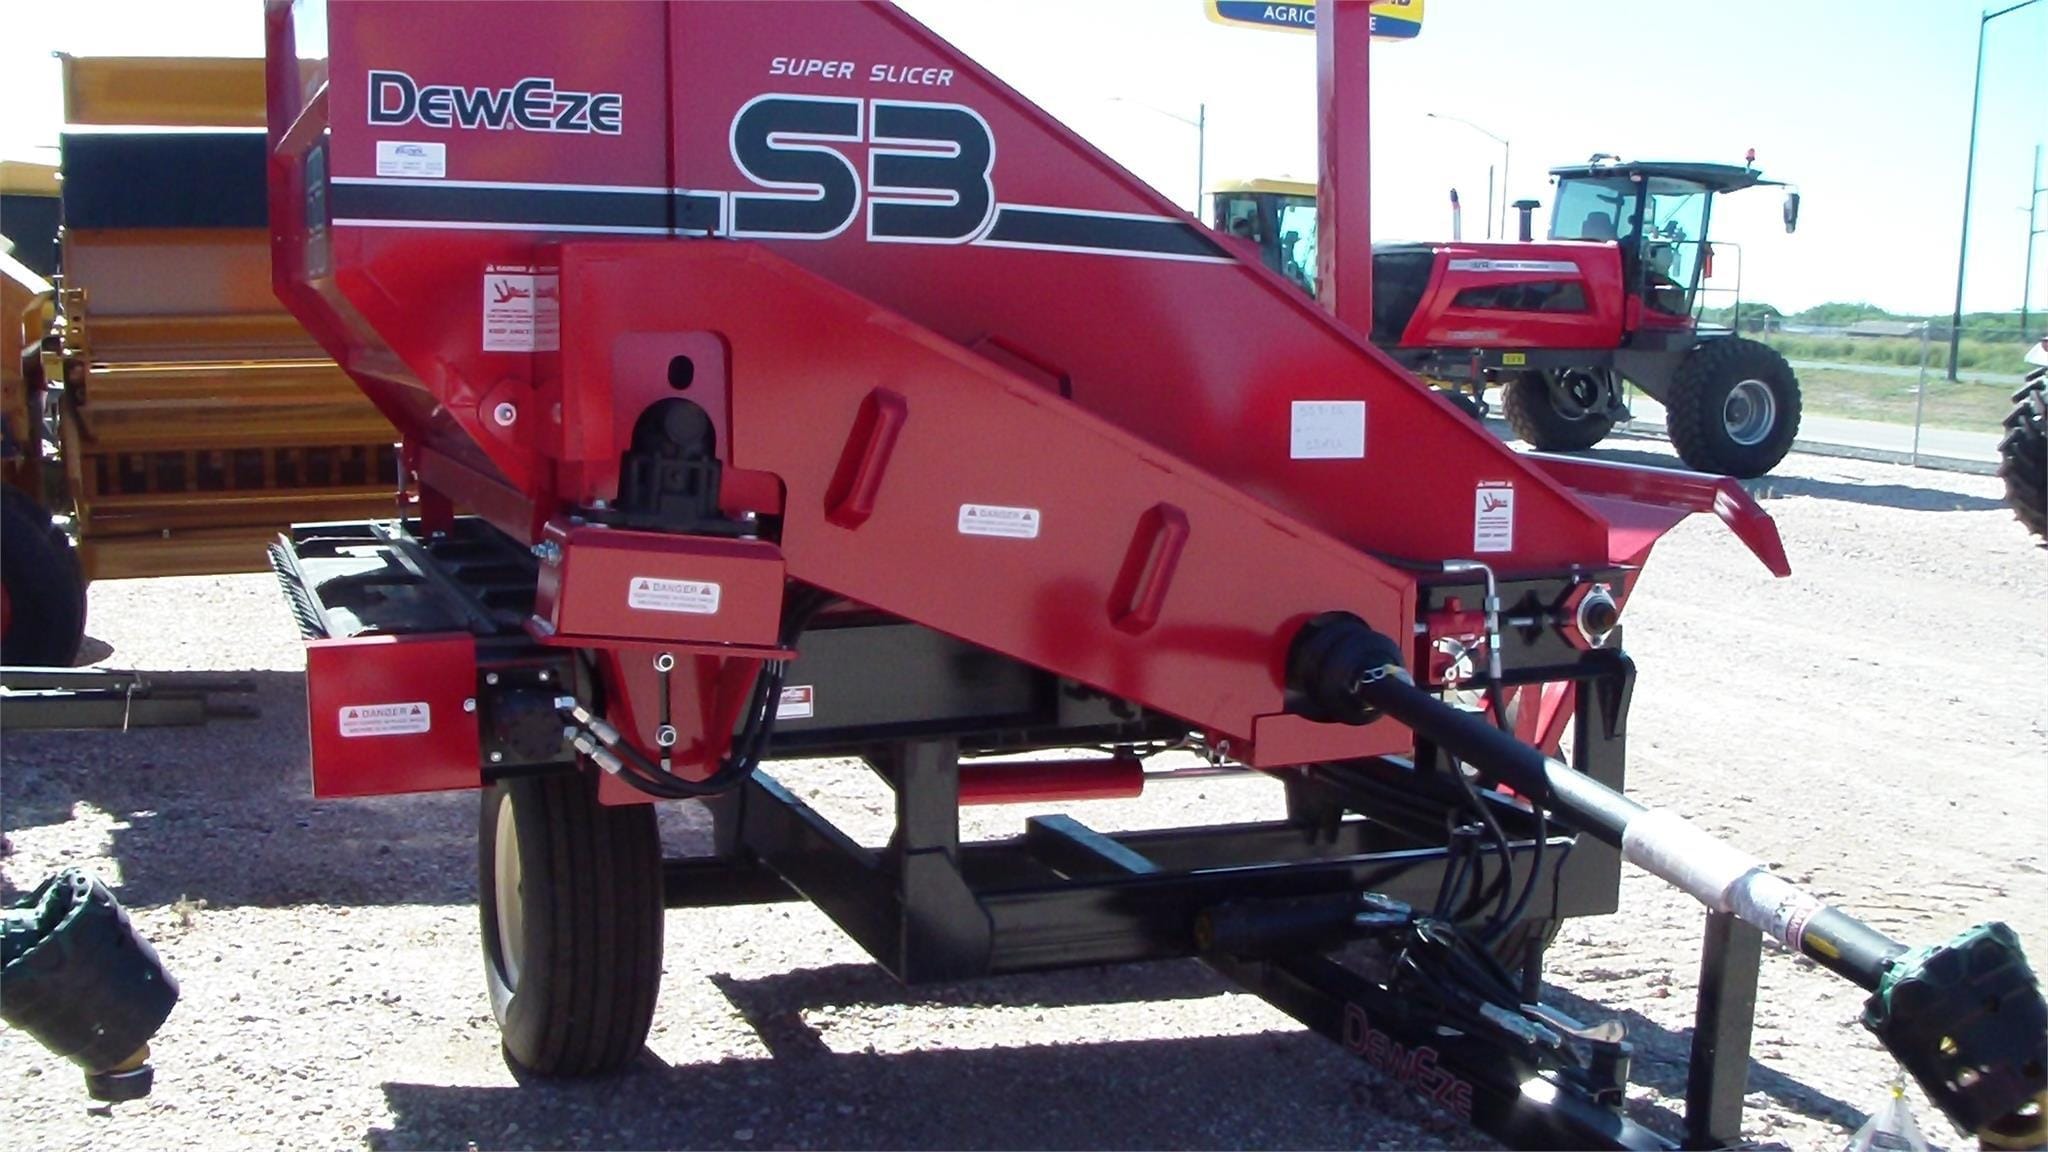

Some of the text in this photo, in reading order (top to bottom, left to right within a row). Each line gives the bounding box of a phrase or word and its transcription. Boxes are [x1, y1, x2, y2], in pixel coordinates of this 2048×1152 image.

[769, 57, 954, 86] SUPER SLICER
[729, 93, 996, 244] S3
[653, 582, 697, 594] DANGER
[362, 707, 407, 719] DANGER
